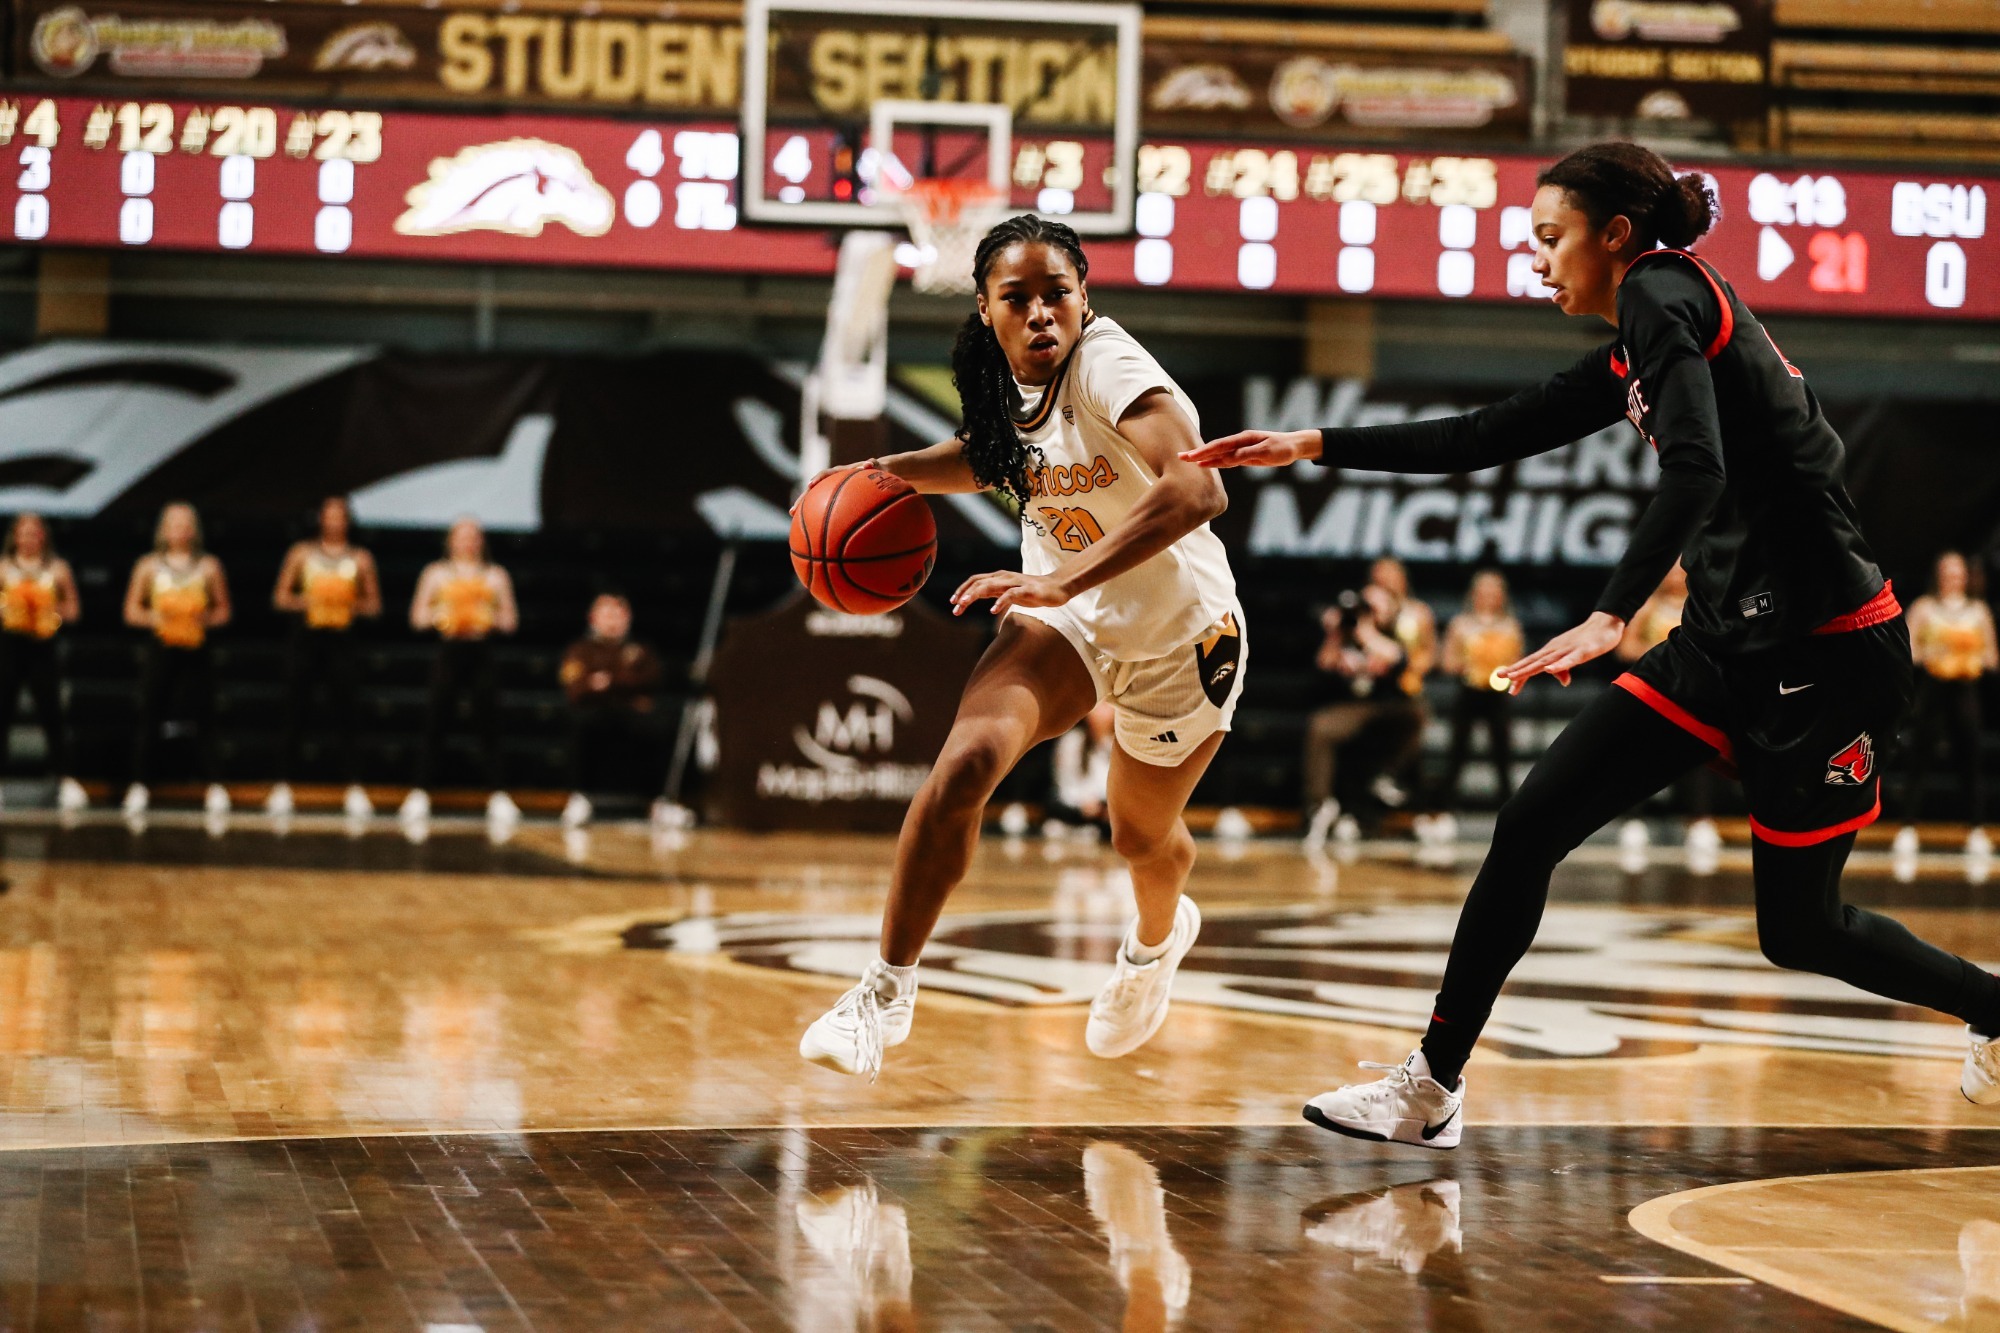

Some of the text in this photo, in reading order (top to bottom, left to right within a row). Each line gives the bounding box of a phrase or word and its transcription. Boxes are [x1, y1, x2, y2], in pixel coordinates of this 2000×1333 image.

[83, 102, 174, 155] #12
[180, 106, 277, 158] #20
[285, 110, 382, 163] #23
[626, 129, 665, 177] 4
[773, 136, 812, 183] 4
[17, 146, 51, 191] 3
[121, 151, 155, 196] 0
[220, 155, 255, 201] 0
[1013, 141, 1085, 190] #3
[14, 194, 49, 240] 0
[120, 198, 153, 244] 0
[218, 201, 254, 249] 0
[624, 180, 662, 228] 0
[1891, 181, 1986, 238] BSU
[1808, 230, 1869, 292] 21
[1925, 241, 1967, 308] 0
[1759, 598, 1768, 608] M
